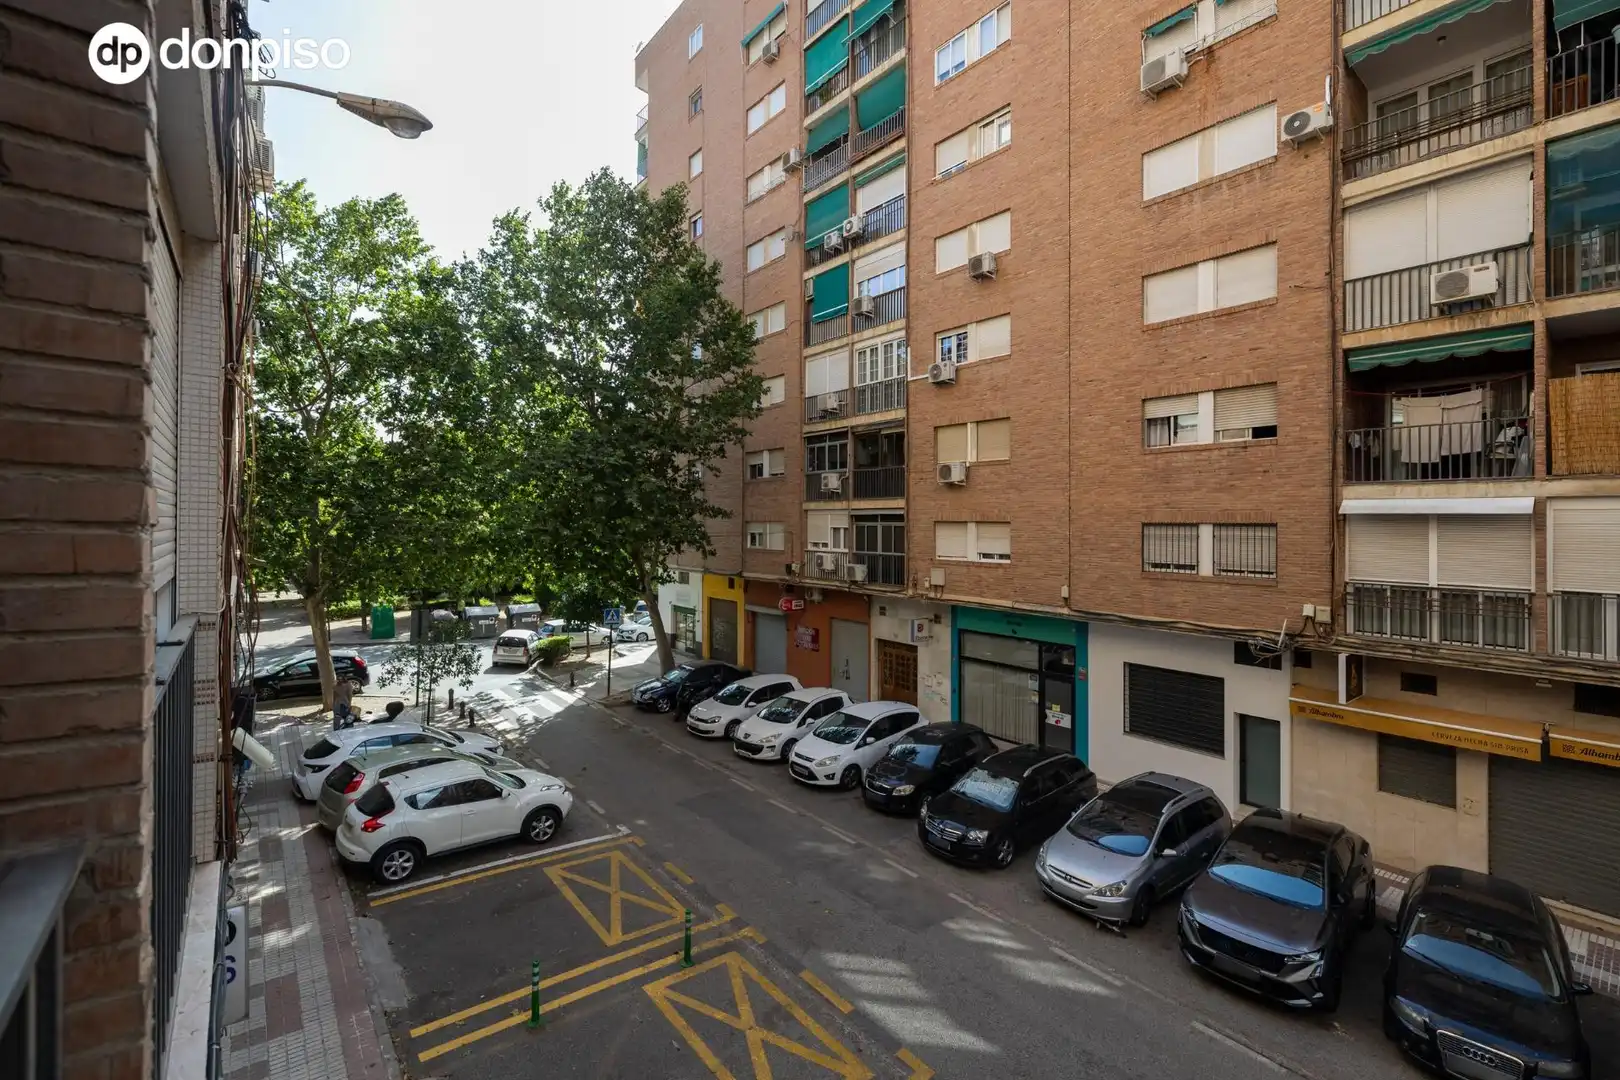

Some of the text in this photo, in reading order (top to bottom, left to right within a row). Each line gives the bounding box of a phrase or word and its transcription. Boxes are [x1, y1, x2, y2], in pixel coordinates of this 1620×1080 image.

[1309, 707, 1344, 720] Alhambra
[1431, 731, 1462, 742] CERVEZA
[1463, 737, 1488, 747] HECHA
